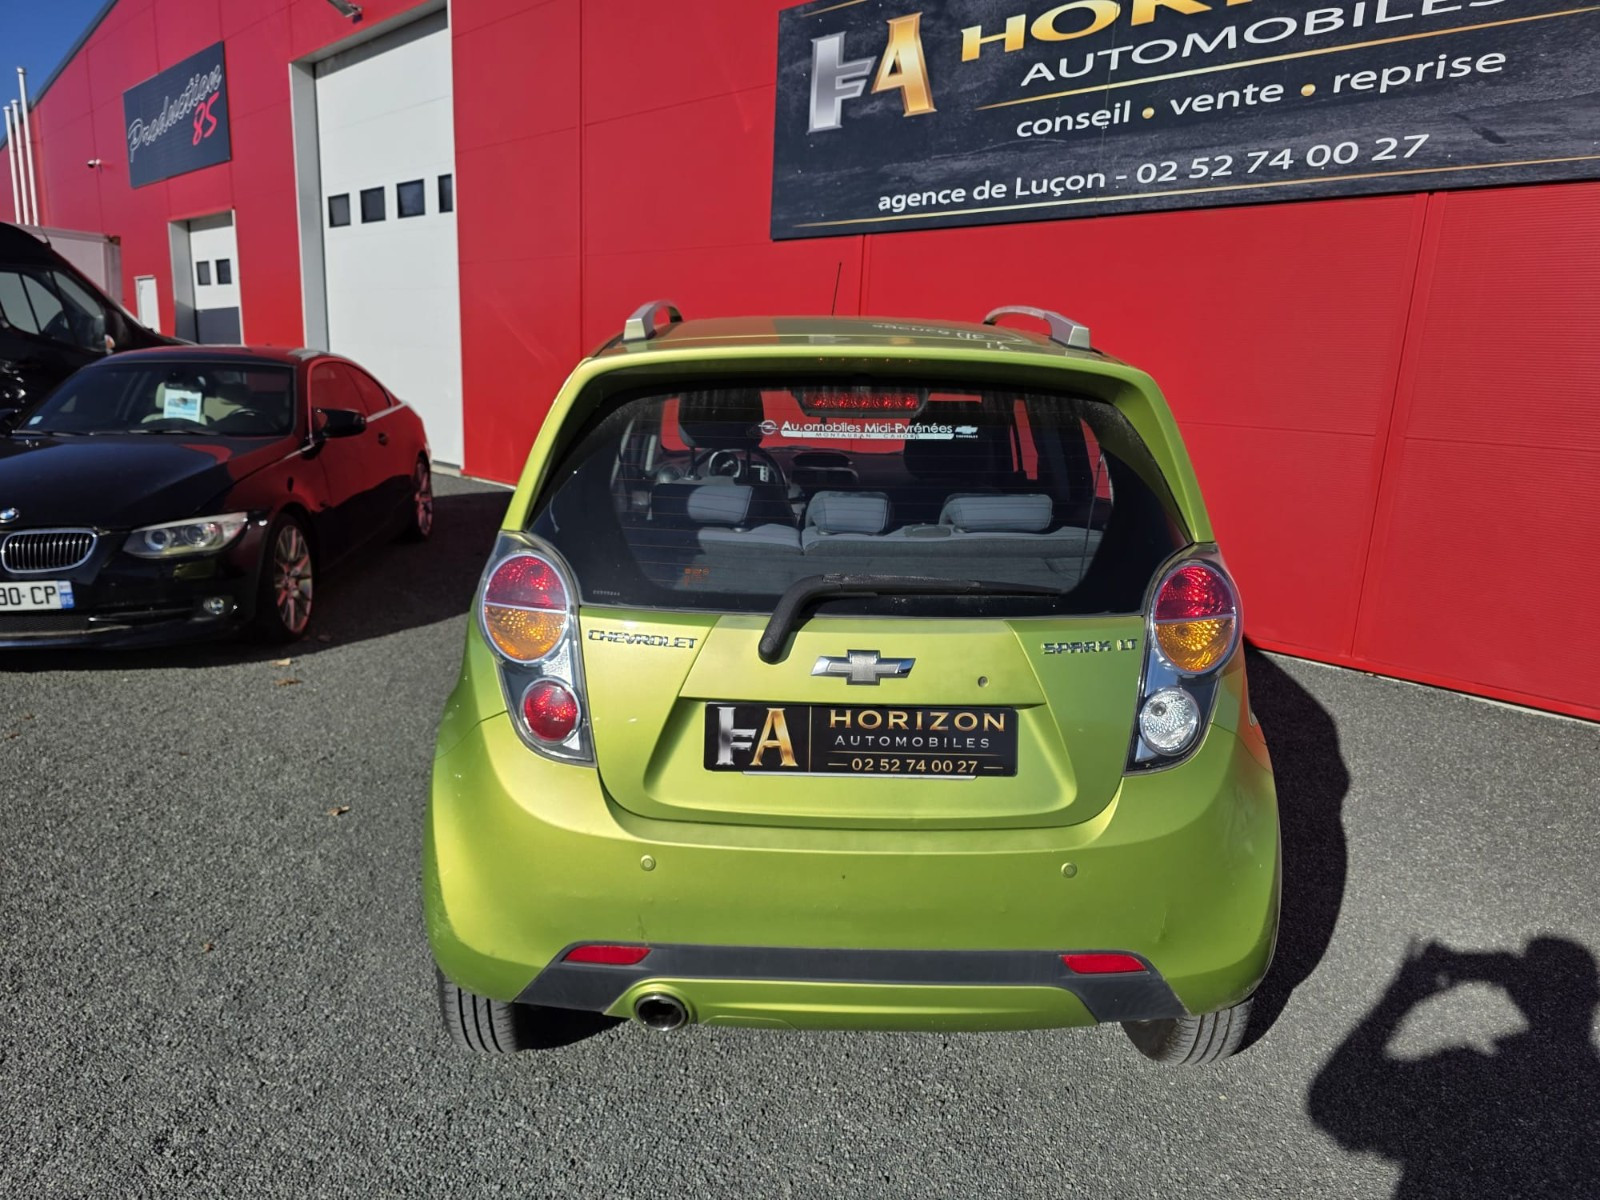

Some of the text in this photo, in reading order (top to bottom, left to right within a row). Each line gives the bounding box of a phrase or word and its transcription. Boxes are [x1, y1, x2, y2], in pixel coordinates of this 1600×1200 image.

[1021, 0, 1505, 86] AUTOMOBILE
[1016, 52, 1506, 137] conseil vente reprise
[192, 91, 220, 146] 85
[878, 186, 967, 212] agence
[973, 180, 1008, 201] de
[1015, 171, 1106, 199] Luçon
[1136, 161, 1178, 184] 02
[1188, 155, 1233, 179] 52
[1247, 148, 1294, 174] 74
[1306, 141, 1359, 167] 00
[1371, 134, 1430, 161] 27
[864, 421, 953, 434] Midi-Pyrénées
[588, 629, 698, 649] CHEVROLET
[1041, 638, 1138, 655] SPARK LT
[829, 709, 1006, 732] HORIZON
[834, 734, 991, 749] AUTOMOBILES
[851, 757, 978, 774] 02 52 74 00 27
